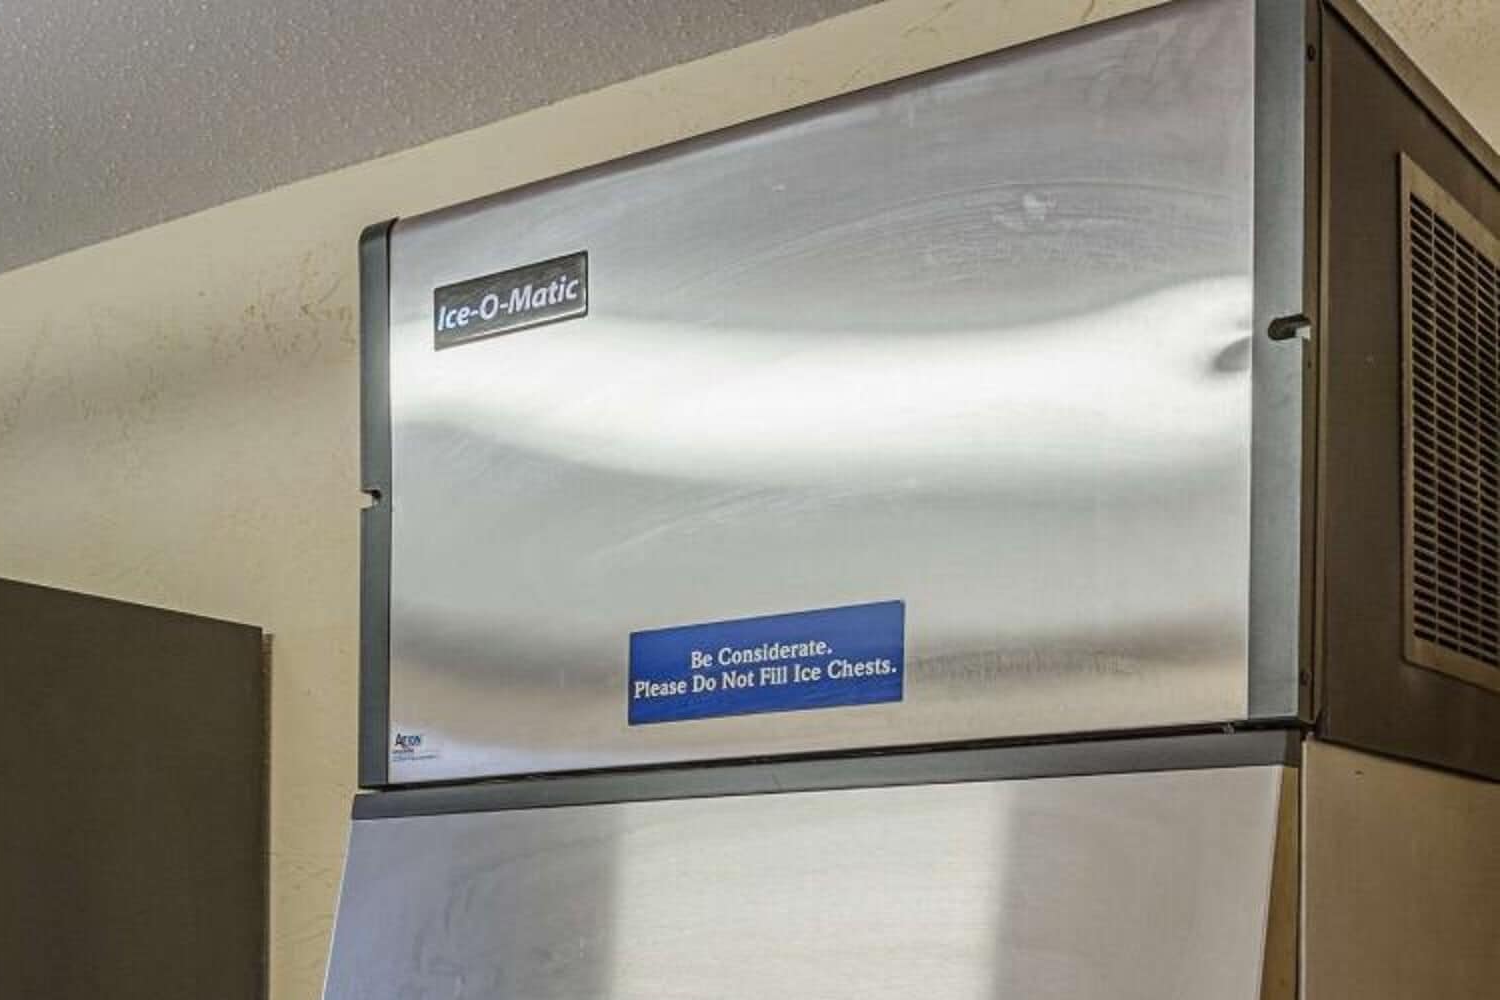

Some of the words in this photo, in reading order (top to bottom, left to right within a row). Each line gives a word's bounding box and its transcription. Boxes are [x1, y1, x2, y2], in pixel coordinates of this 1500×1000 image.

[437, 275, 579, 331] Ice-O-Matic
[691, 651, 713, 669] Be
[718, 640, 833, 665] Considerate.
[634, 680, 687, 699] Please
[693, 675, 717, 693] Do
[722, 671, 754, 689] Not
[759, 667, 788, 686] Fill
[793, 664, 821, 682] Ice
[827, 658, 897, 679] Chests.
